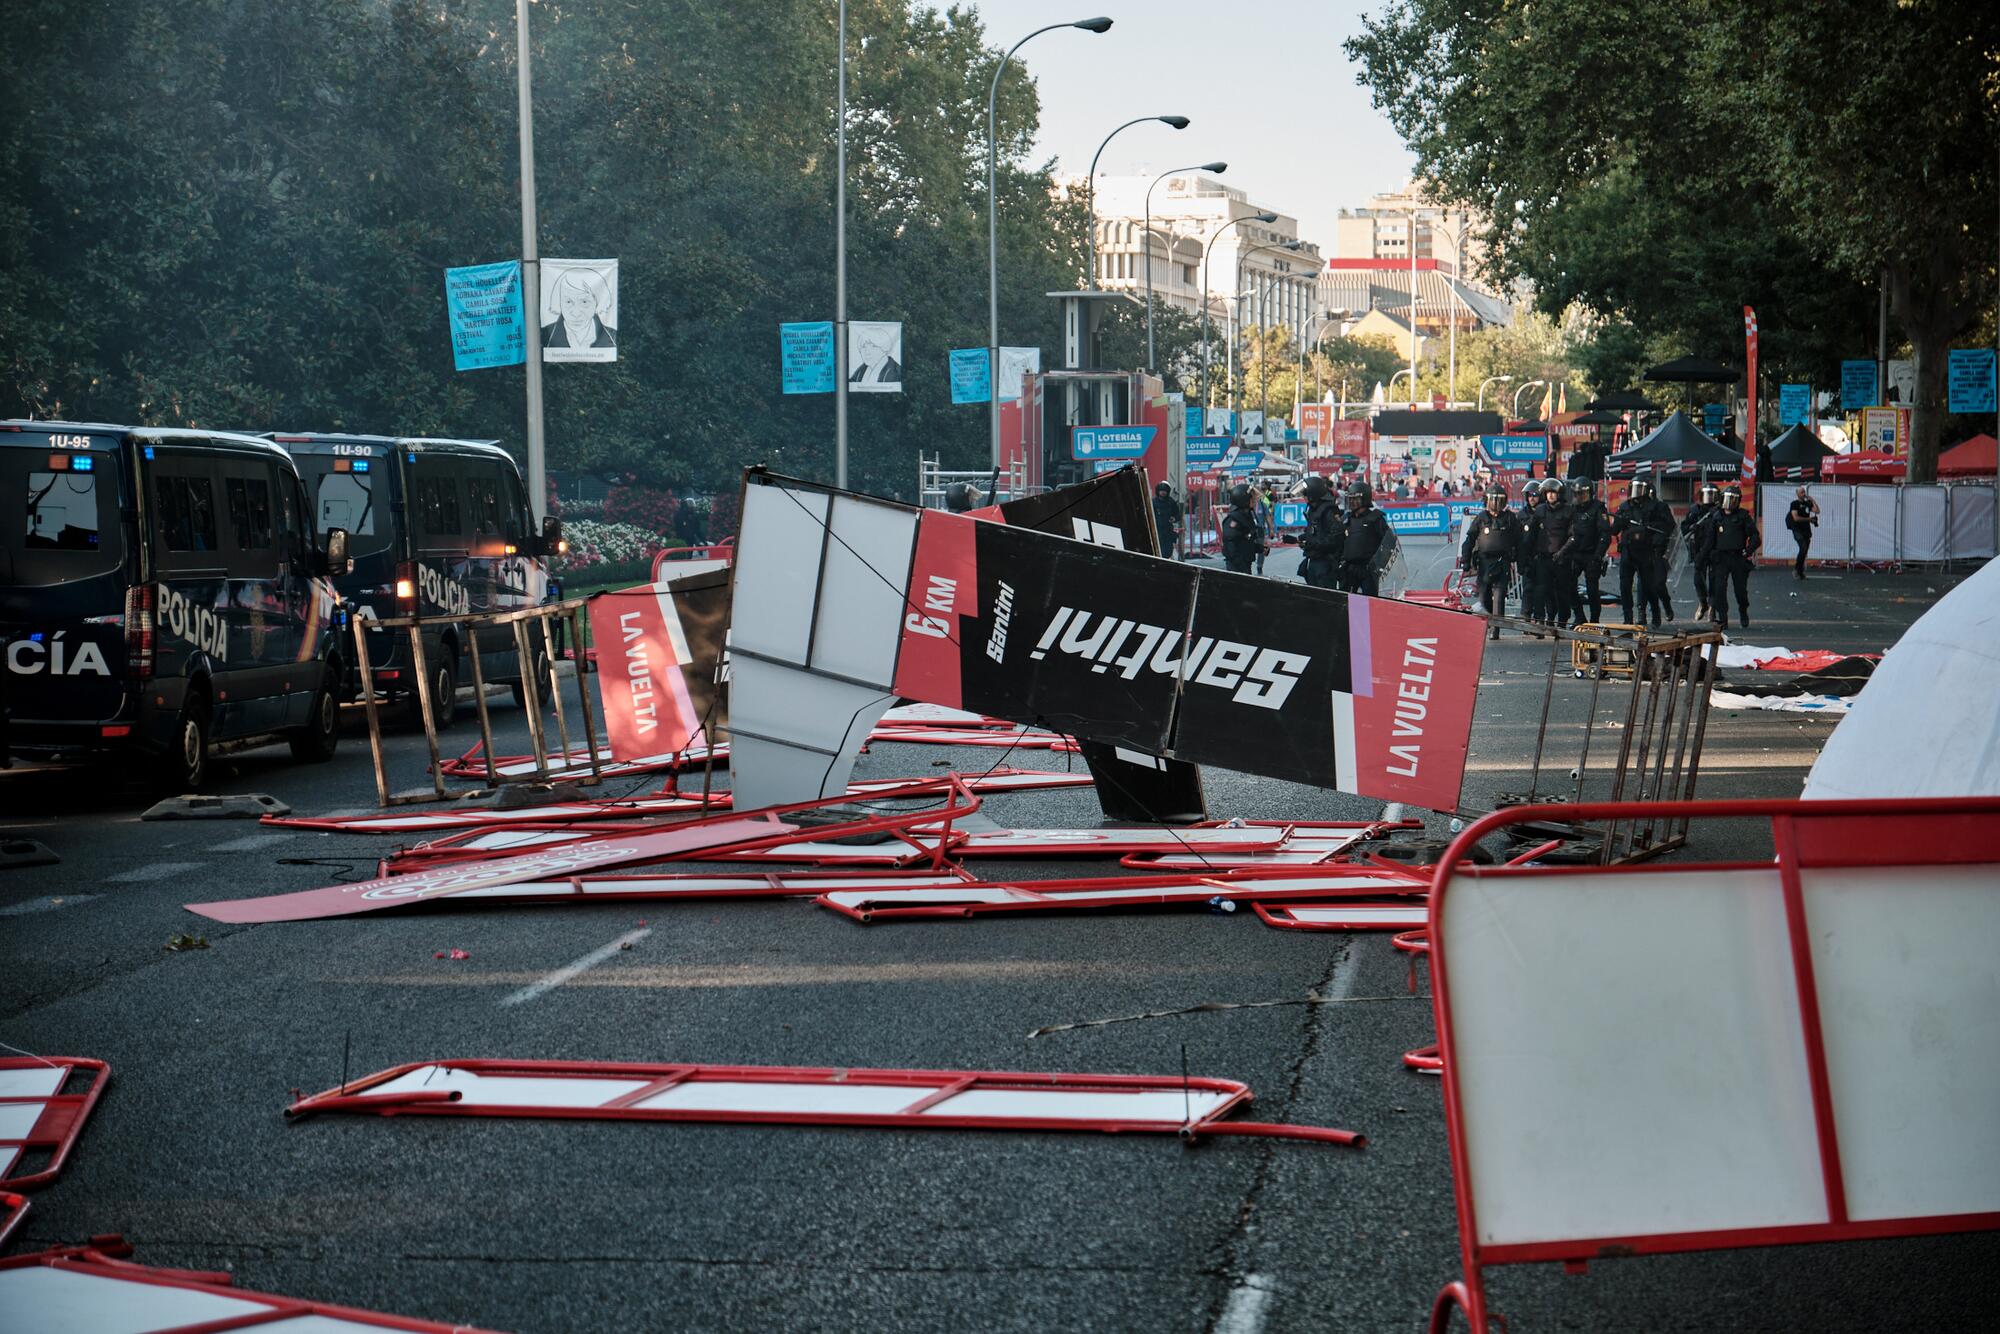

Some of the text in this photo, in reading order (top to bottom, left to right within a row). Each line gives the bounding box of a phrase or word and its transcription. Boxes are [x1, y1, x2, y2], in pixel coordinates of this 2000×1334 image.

[455, 331, 483, 340] FESTIVAL
[49, 435, 91, 449] 1U-95
[1098, 432, 1142, 442] LOTERÍAS
[332, 444, 372, 456] 1U-90
[1186, 442, 1220, 450] LOTERÍAS
[1508, 440, 1543, 448] LOTERÍAS
[1712, 464, 1736, 472] VUELTA
[1188, 477, 1203, 485] 175
[1387, 510, 1439, 520] LOTERÍAS
[418, 562, 470, 616] POLICÍA
[905, 575, 957, 639] 6 KM
[158, 583, 227, 663] POLICÍA
[986, 579, 1015, 665] Santini
[1029, 606, 1312, 711] Santini
[619, 611, 658, 735] LA VUELTA
[1386, 637, 1438, 777] LA VUELTA
